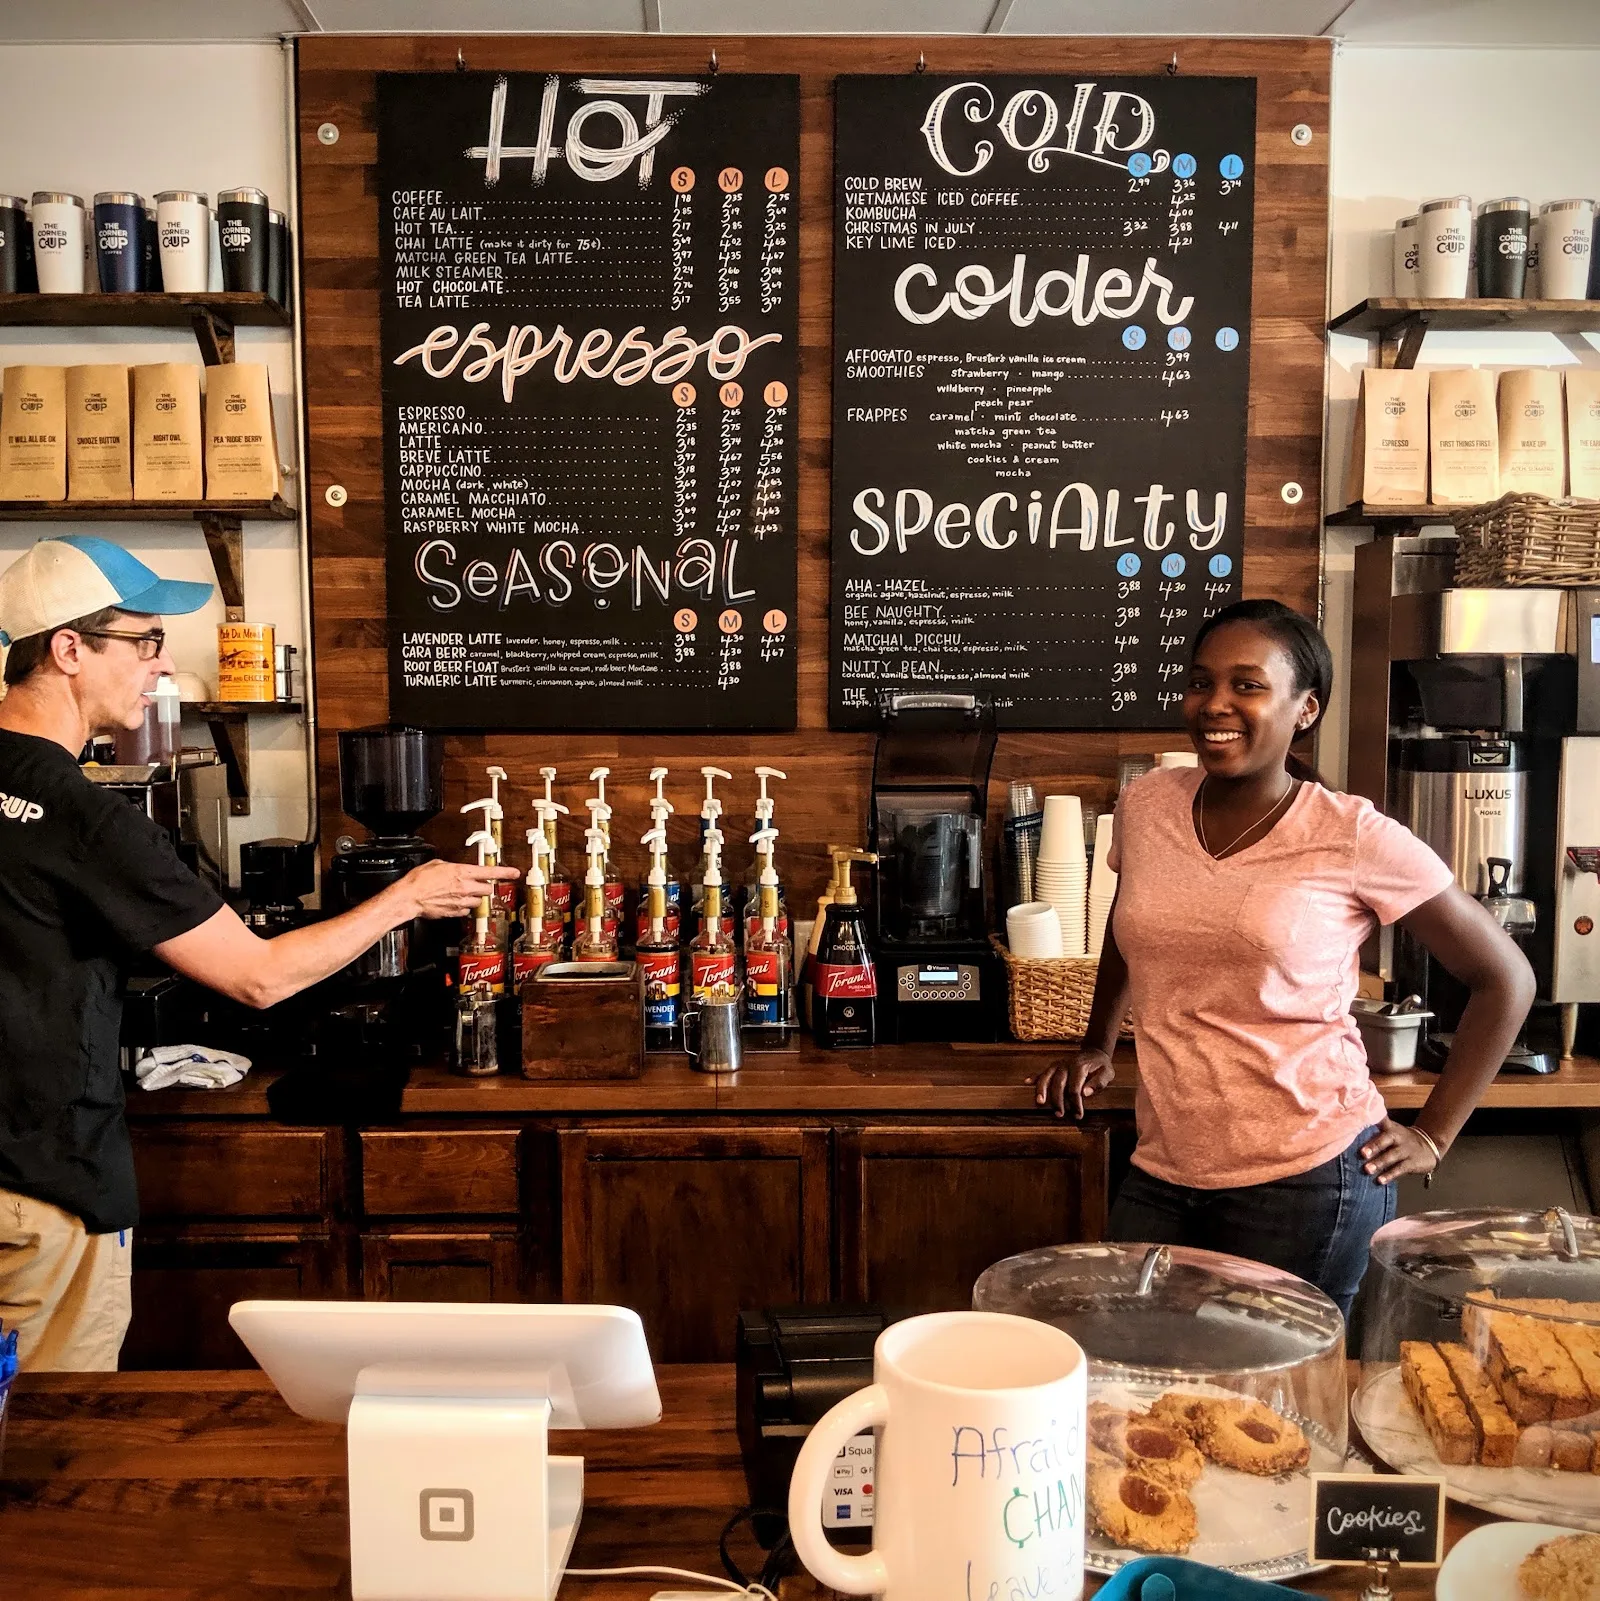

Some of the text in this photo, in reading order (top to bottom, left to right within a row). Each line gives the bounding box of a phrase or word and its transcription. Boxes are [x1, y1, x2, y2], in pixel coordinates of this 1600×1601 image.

[462, 74, 714, 190] HOT
[845, 177, 879, 190] COLD
[885, 177, 922, 191] BREW
[393, 190, 442, 206] COFFEE
[846, 191, 927, 205] VIETNAMESE
[938, 192, 964, 205] ICED
[971, 193, 1019, 206] COFFEE
[846, 206, 916, 220] KOMBUCHA
[104, 222, 119, 230] THE
[227, 219, 242, 227] THE
[99, 229, 128, 237] CORNER
[222, 226, 251, 234] CORNER
[1508, 227, 1523, 235] THE
[38, 237, 67, 249] CUP
[99, 237, 129, 250] CUP
[162, 236, 190, 248] CUP
[222, 234, 251, 247] CUP
[396, 236, 425, 250] CHAI
[435, 237, 473, 250] LATTE
[518, 240, 524, 248] it
[529, 239, 552, 250] dirty
[557, 240, 570, 248] for
[1499, 234, 1528, 242] CORNER
[1436, 242, 1465, 254] CUP
[1498, 242, 1527, 255] CUP
[1562, 243, 1589, 255] CUP
[894, 254, 1195, 327] colder
[845, 349, 912, 363] AFFOGATO
[1009, 354, 1039, 363] vanilla
[1043, 355, 1054, 363] ice
[393, 323, 782, 403] espresso
[847, 365, 925, 378] SMOOTHIES
[951, 368, 1009, 380] strawberry
[1032, 371, 1064, 381] mango
[937, 384, 1052, 397] wildberry pineapple
[975, 398, 1033, 411] peach pear
[399, 406, 465, 420] ESPRESSO
[848, 408, 907, 422] FRAPPES
[930, 410, 974, 421] caramel
[995, 411, 1021, 421] mint
[1029, 413, 1077, 421] chocolate
[153, 434, 169, 442] NIGHT
[955, 427, 1056, 439] matcha green tea
[77, 436, 120, 445] SNOOZE BUTTON
[1382, 439, 1409, 448] ESPRESSO
[1440, 439, 1491, 448] FIRST THINGS FIRST
[1521, 440, 1536, 448] WAKE
[968, 455, 1007, 463] cookies
[1013, 455, 1019, 463] &
[996, 468, 1031, 477] mocha
[403, 633, 463, 645] LAVENDER
[469, 633, 502, 644] LATTE
[844, 633, 903, 647] MATCHAI
[915, 633, 960, 646] PICCHU
[404, 674, 461, 687] TURMERIC
[465, 675, 497, 686] LATTE
[1464, 789, 1512, 800] LUXUS
[460, 960, 503, 985] Torani
[828, 970, 867, 993] Torani
[951, 1409, 1079, 1487] Afraid
[834, 1488, 853, 1496] VISA
[1327, 1504, 1426, 1535] Cookies
